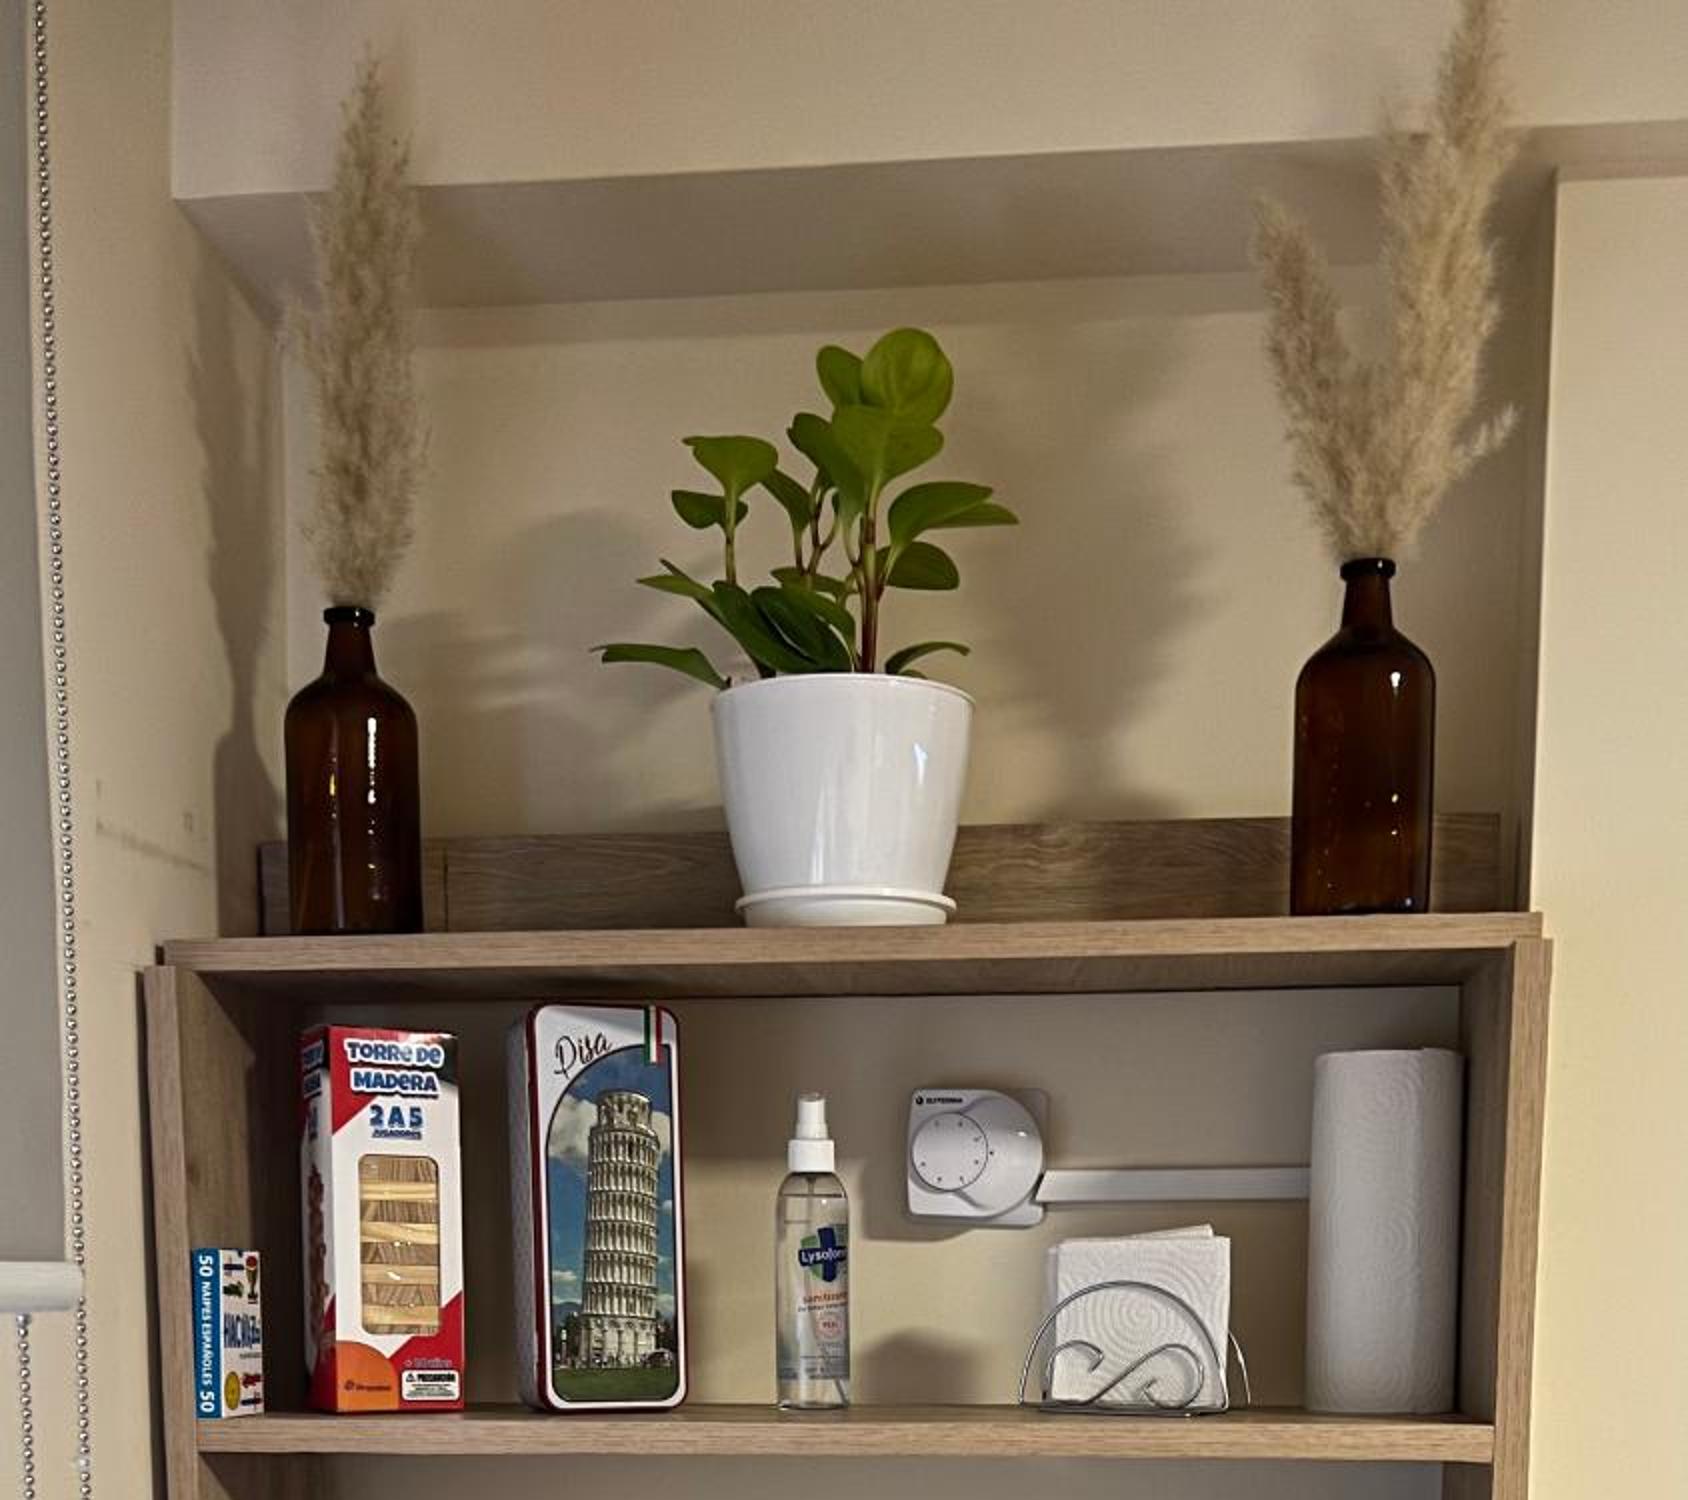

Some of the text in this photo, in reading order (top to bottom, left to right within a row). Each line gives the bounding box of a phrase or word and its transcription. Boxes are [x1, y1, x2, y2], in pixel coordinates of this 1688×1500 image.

[554, 1032, 612, 1080] Pisa
[369, 1103, 423, 1129] 2 A 5
[198, 1254, 214, 1278] 50
[199, 1390, 215, 1413] 50
